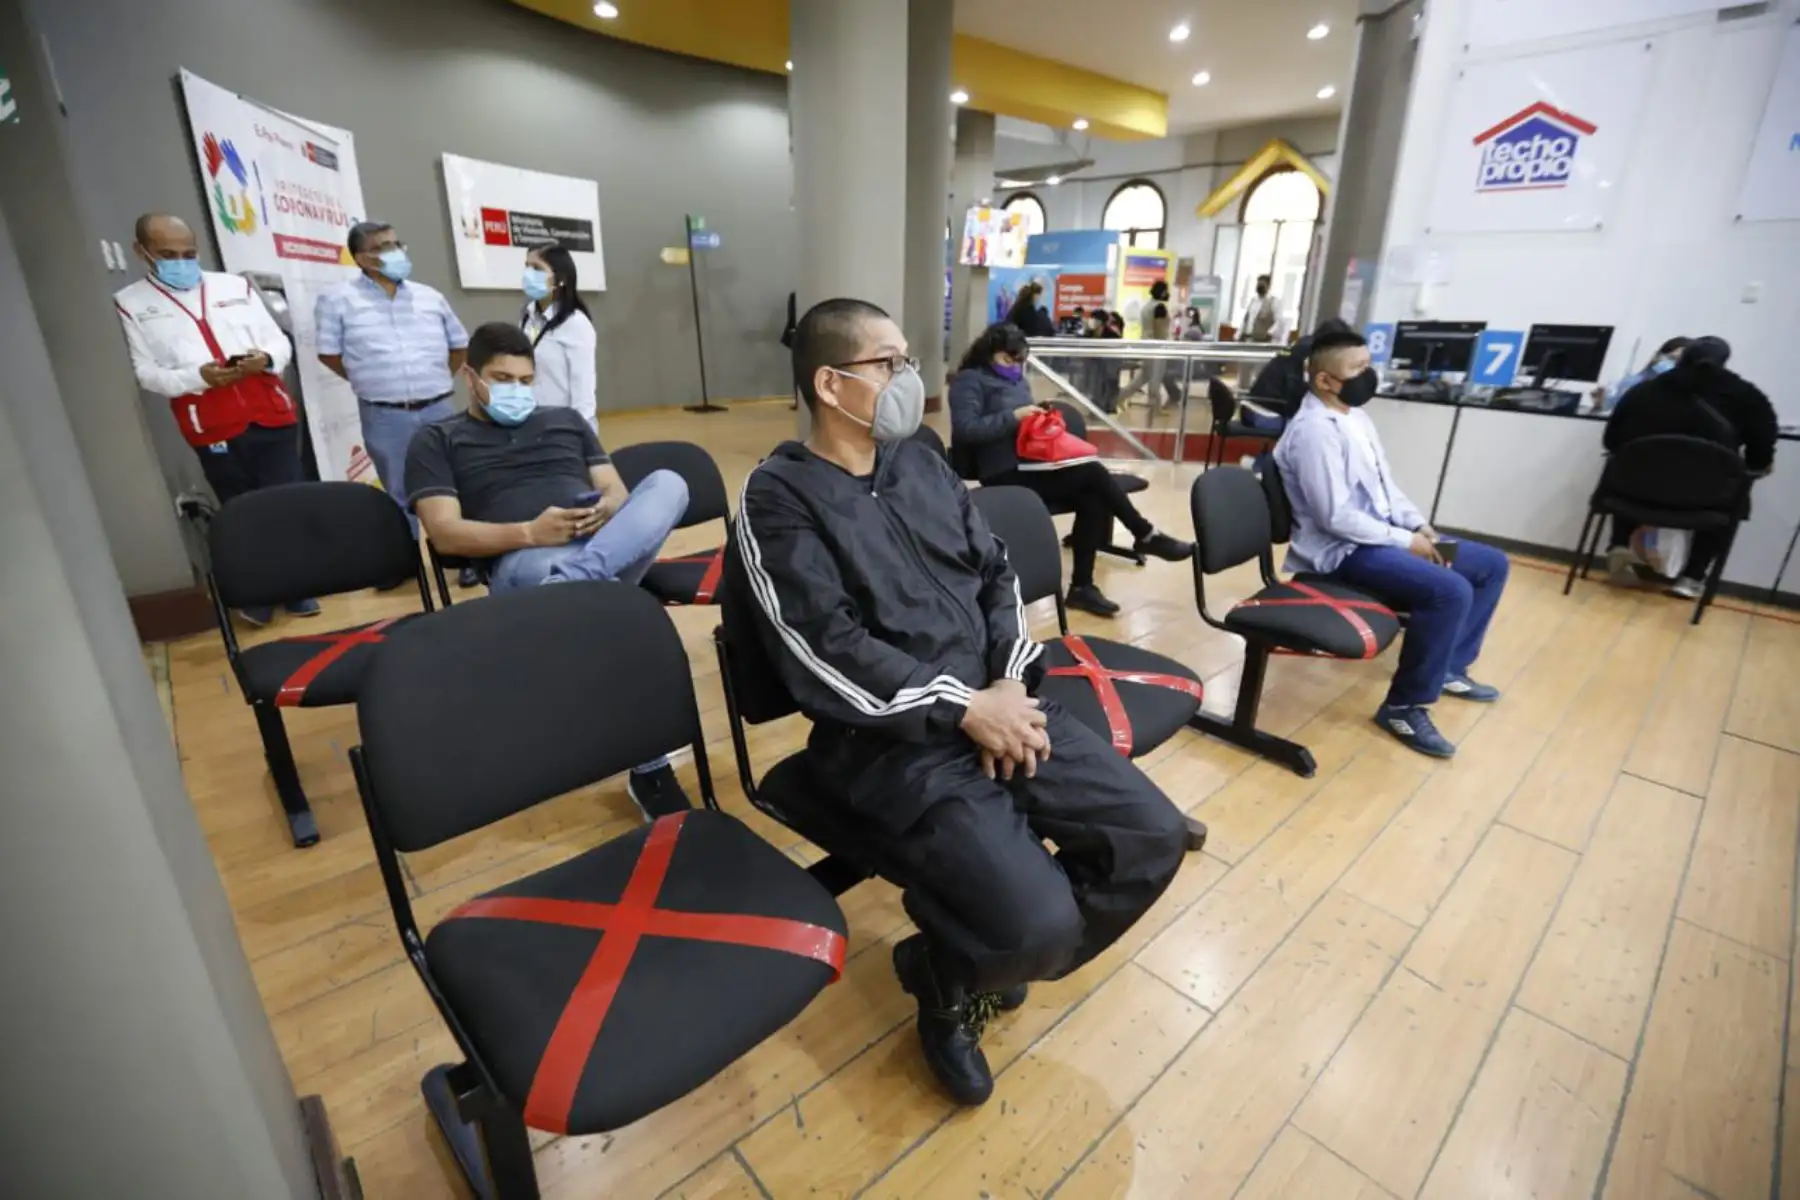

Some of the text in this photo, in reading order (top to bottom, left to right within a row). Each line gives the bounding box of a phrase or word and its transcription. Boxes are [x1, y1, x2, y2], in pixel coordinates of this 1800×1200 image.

[1485, 133, 1572, 162] techo
[1479, 156, 1572, 186] propio
[1368, 330, 1386, 354] 8
[1483, 342, 1514, 376] 7
